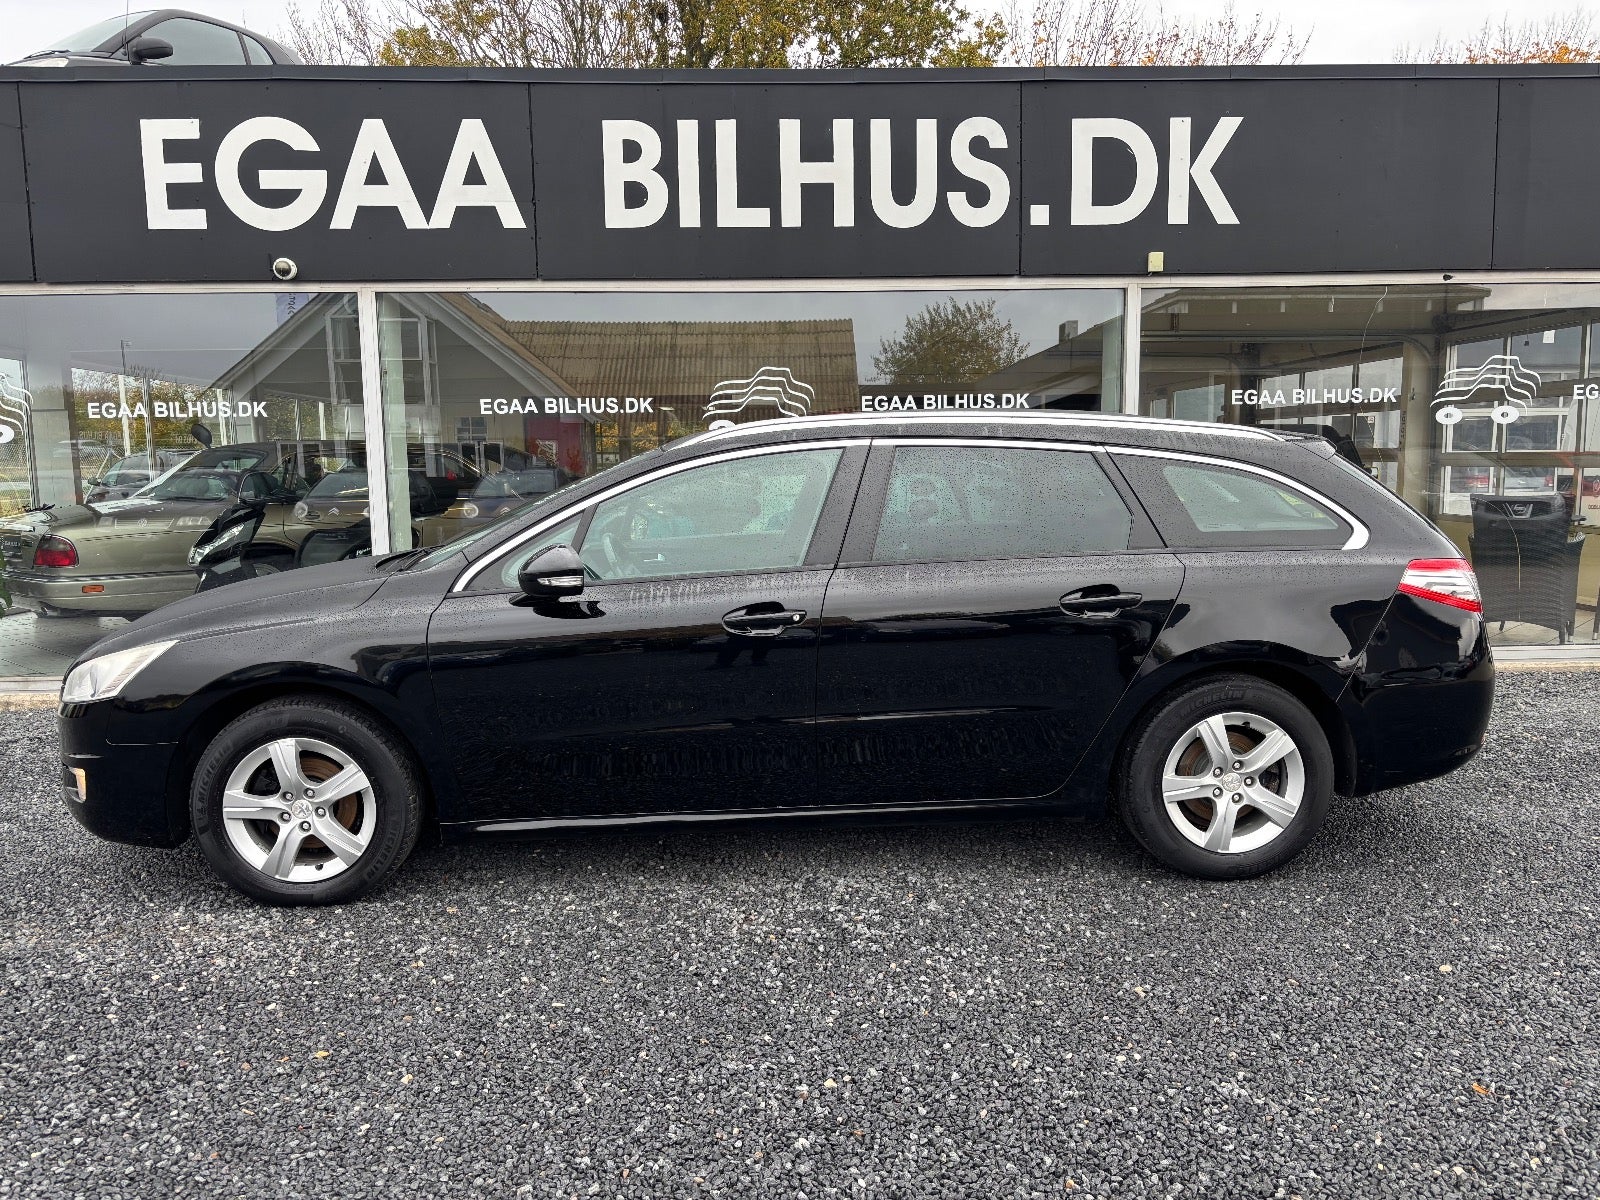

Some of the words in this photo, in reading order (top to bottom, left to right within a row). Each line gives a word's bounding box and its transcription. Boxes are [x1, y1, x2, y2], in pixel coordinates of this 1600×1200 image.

[139, 117, 527, 231] EGAA
[602, 116, 1245, 228] BILHUS.DK
[1231, 389, 1286, 405] EGAA
[1292, 387, 1397, 404] BILHUS.DK
[1573, 384, 1600, 400] EG
[87, 402, 148, 418] EGAA
[154, 401, 268, 418] BILHUS.DK
[480, 398, 538, 414] EGAA
[544, 397, 654, 414] BILHUS.DK
[861, 395, 917, 411] EGAA
[923, 393, 1030, 409] BILHUS.DK
